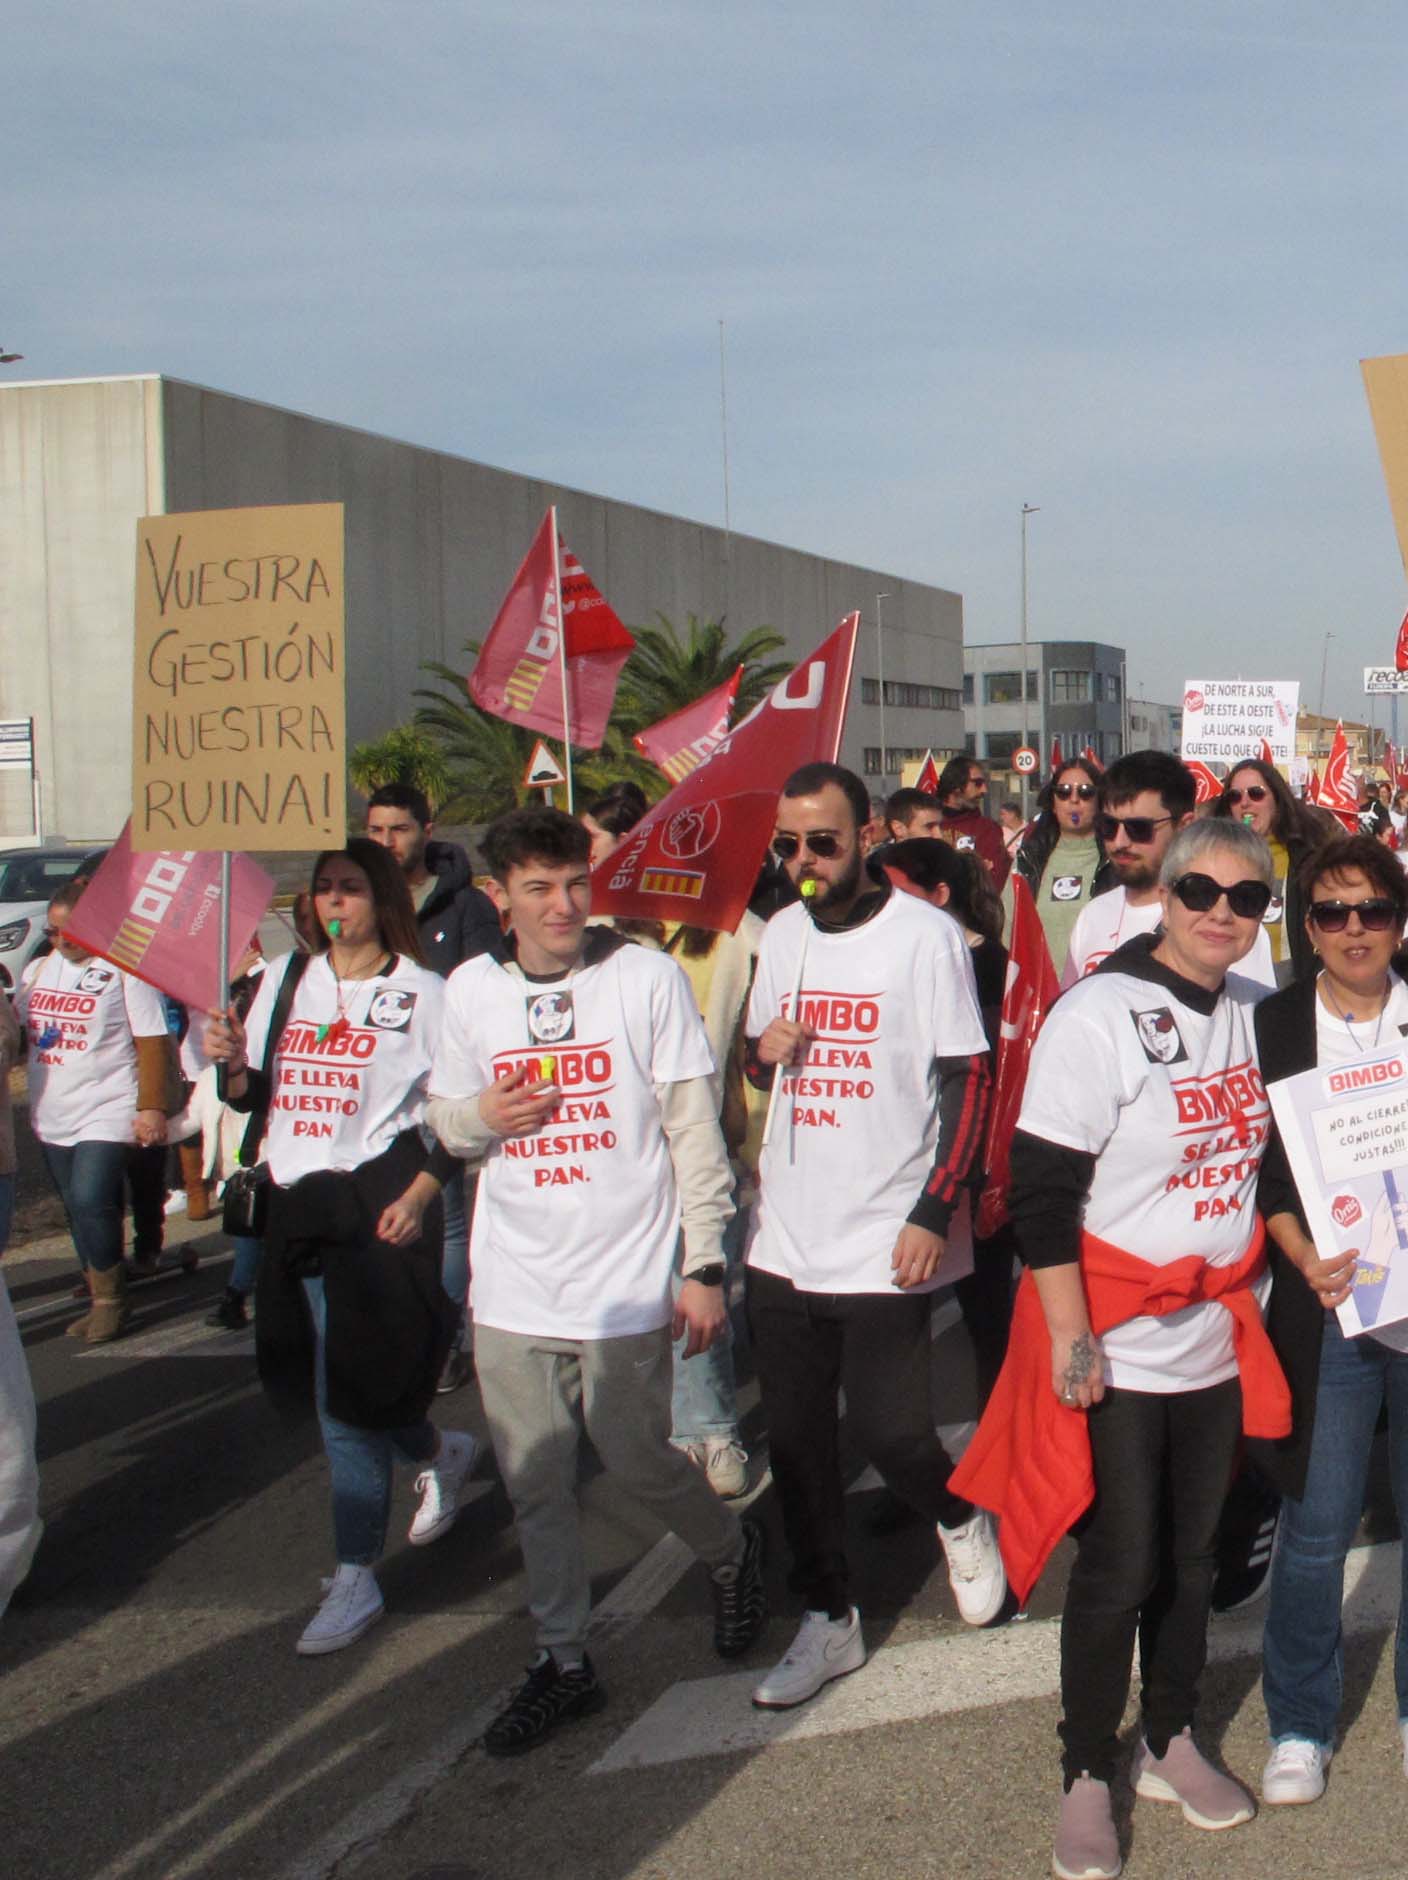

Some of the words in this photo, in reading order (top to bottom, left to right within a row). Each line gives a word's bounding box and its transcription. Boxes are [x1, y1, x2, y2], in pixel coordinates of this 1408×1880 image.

[146, 535, 331, 615] VUESTRA
[149, 623, 335, 696] GESTIÓN
[1204, 684, 1215, 696] DE
[1218, 684, 1246, 697] NORTE
[1248, 685, 1255, 697] A
[1204, 704, 1216, 716] DE
[1217, 704, 1238, 716] ESTE
[1239, 704, 1245, 716] A
[1247, 704, 1274, 717] OESTE
[145, 705, 335, 764] NUESTRA
[1217, 724, 1246, 736] LUCHA
[1248, 724, 1275, 737] SIGUE
[1186, 742, 1218, 755] CUESTE
[1220, 743, 1231, 756] LO
[1233, 744, 1251, 757] QUE
[1253, 744, 1287, 757] CSTE!
[1018, 755, 1033, 766] 20
[144, 771, 332, 834] RUINA!
[28, 993, 96, 1014] BIMBO
[302, 1069, 360, 1090] LLEVA
[1329, 1060, 1405, 1093] BIMBO
[791, 1107, 841, 1128] PAN.
[1329, 1118, 1345, 1133] NO
[1349, 1115, 1363, 1129] AL
[504, 1130, 617, 1160] NUESTRO
[1353, 1138, 1406, 1162] JUSTAS!!!
[534, 1165, 591, 1187] PAN.
